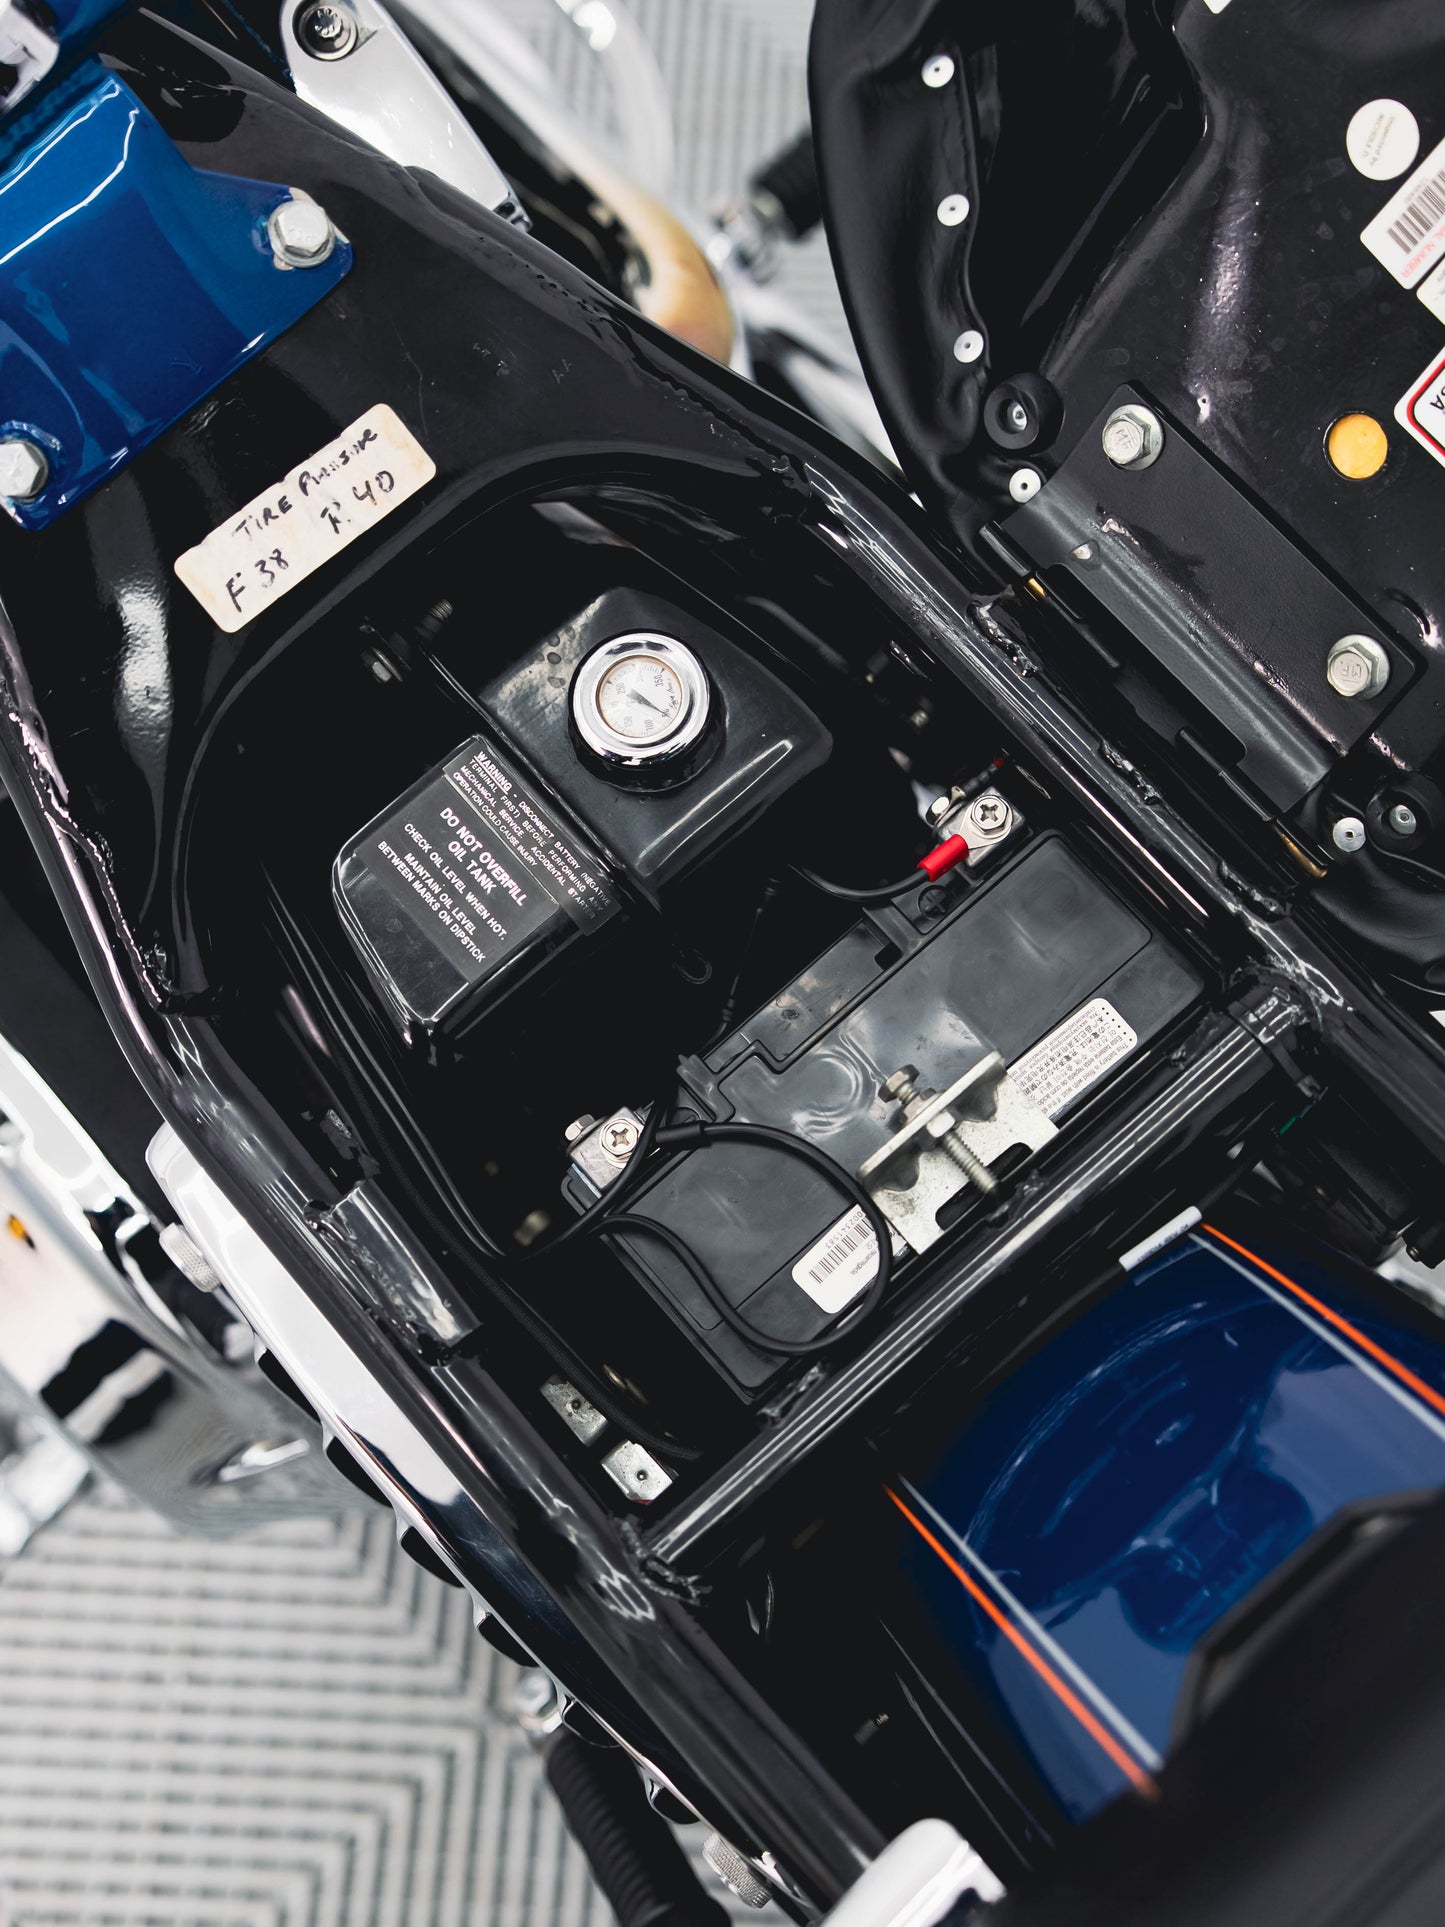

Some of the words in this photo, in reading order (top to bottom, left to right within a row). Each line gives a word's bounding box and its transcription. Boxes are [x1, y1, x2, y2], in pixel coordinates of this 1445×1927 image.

[1401, 242, 1434, 277] NUMBER
[232, 495, 293, 541] TIRE
[255, 548, 289, 588] 38
[352, 470, 395, 506] 40
[439, 807, 460, 828] DO
[456, 825, 481, 853] NOT
[477, 849, 528, 907] OVERFILL
[447, 839, 468, 862] OIL
[465, 859, 496, 894] TANK
[452, 771, 483, 806] OPERATION
[481, 804, 500, 826] COULD
[499, 825, 518, 846] CAUSE
[516, 845, 536, 867] INJURY
[460, 764, 498, 807] MECHANICAL
[499, 808, 525, 839] SERVICE.
[531, 845, 566, 886] ACCIDENTAL
[567, 887, 594, 918] STARTER
[469, 758, 498, 793] TERMINAL
[500, 795, 520, 818] FIRST)
[522, 820, 545, 847] BEFORE
[548, 849, 585, 893] PERFORMING
[476, 750, 512, 792] WARNING
[518, 800, 553, 840] DISCONNECT
[554, 841, 579, 870] BATTERY
[581, 871, 610, 905] (NEGATIVE
[378, 840, 414, 882] BETWEEN
[412, 880, 439, 911] MARKS
[437, 909, 452, 925] ON
[450, 923, 485, 963] DIPSTICK
[403, 822, 431, 853] CHECK
[428, 851, 444, 867] OIL
[442, 865, 466, 893] LEVEL
[464, 892, 489, 919] WHEN
[487, 917, 508, 940] HOT.
[404, 852, 441, 894] MAINTAIN
[438, 892, 454, 908] OIL
[452, 907, 477, 935] LEVEL
[1098, 1050, 1116, 1066] battery
